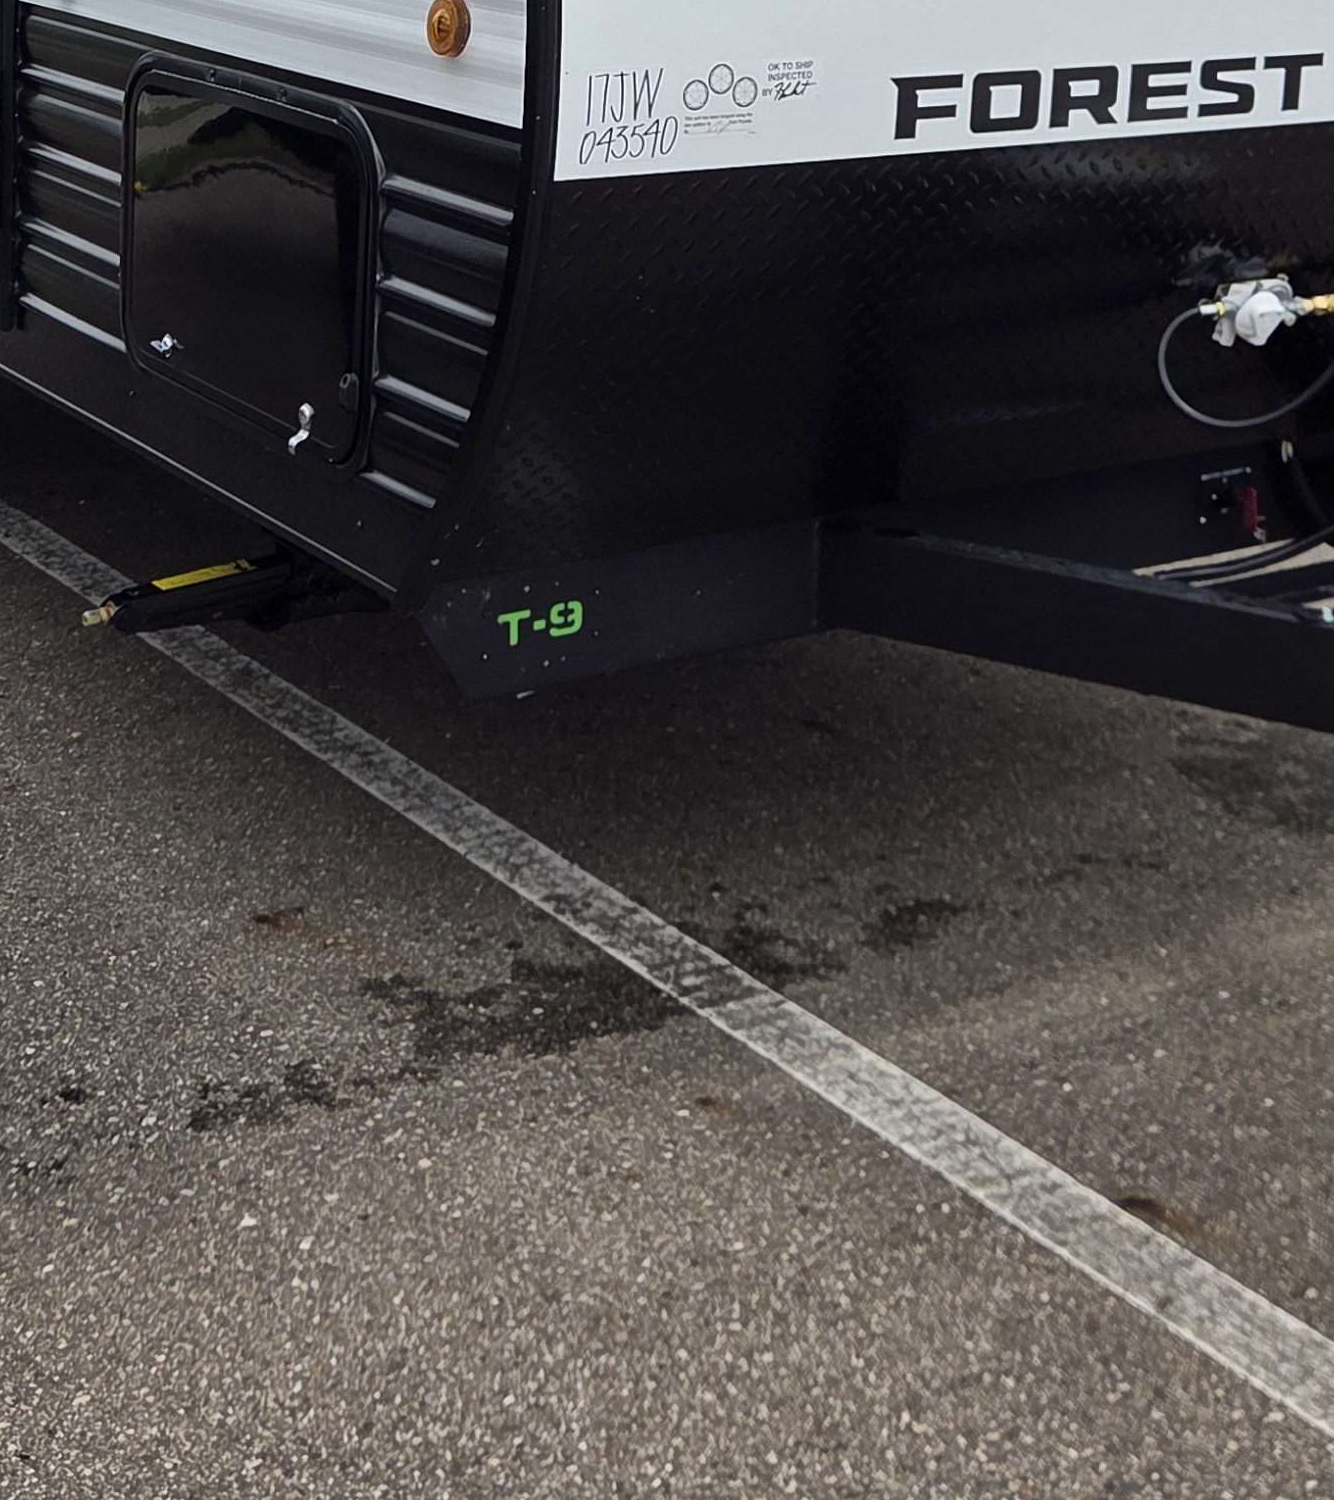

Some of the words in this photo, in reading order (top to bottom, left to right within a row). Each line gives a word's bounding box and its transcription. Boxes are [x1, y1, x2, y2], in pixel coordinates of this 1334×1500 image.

[767, 62, 780, 72] OK
[782, 61, 794, 71] TO
[795, 60, 814, 70] SHIP
[767, 70, 813, 82] INSPECTED
[761, 87, 773, 98] BY
[889, 52, 1325, 141] FOREST
[579, 115, 679, 166] 043540
[497, 600, 583, 647] T-9
